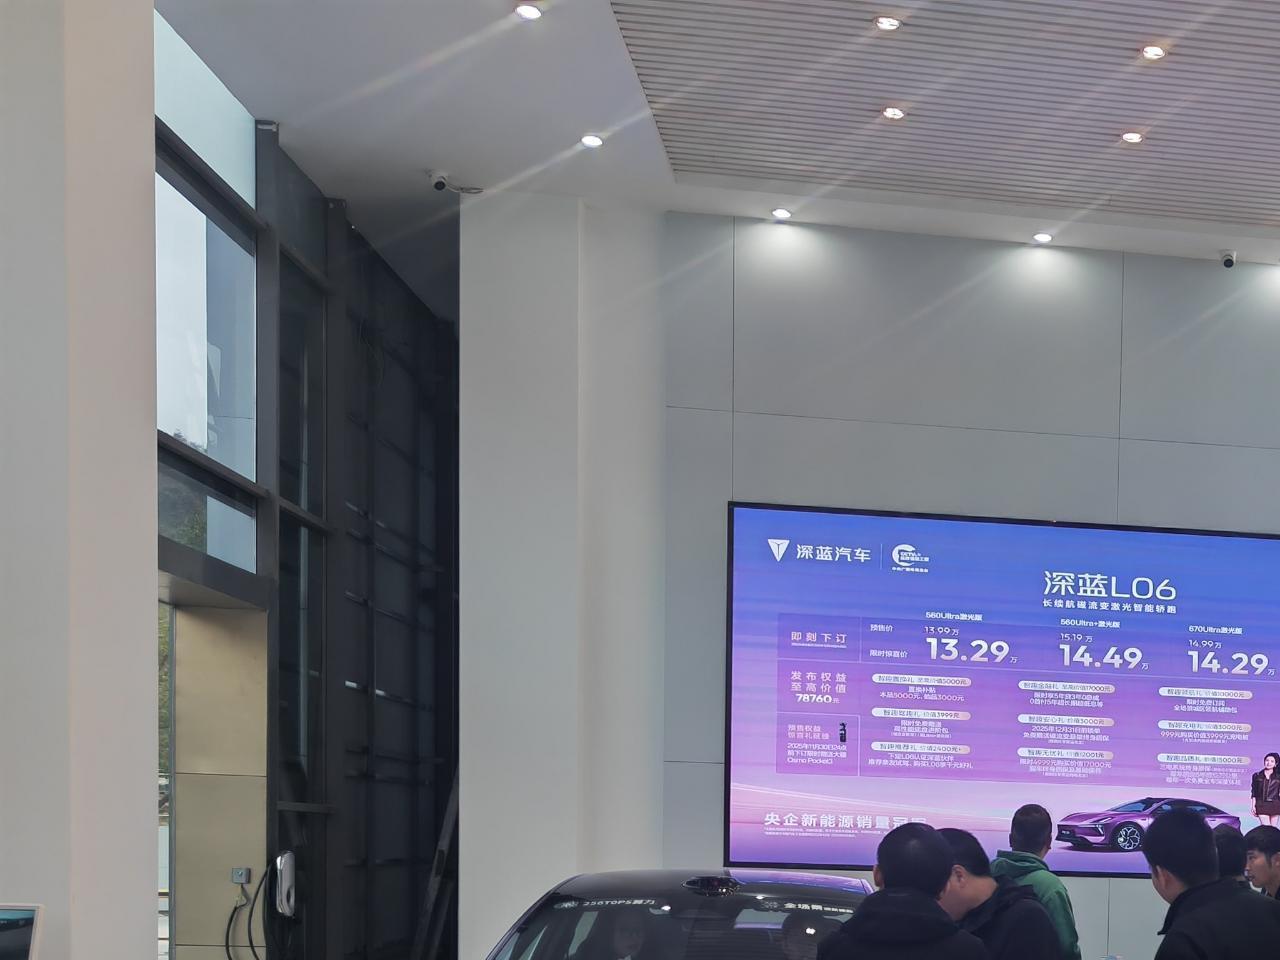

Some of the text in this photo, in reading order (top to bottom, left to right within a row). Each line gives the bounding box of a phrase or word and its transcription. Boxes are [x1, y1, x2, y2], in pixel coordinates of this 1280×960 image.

[796, 544, 871, 563] 深蓝汽车
[1043, 570, 1177, 601] 深蓝L06
[1042, 598, 1177, 614] 长续航磁流变激光智能轿跑
[870, 624, 893, 633] 预售价
[791, 632, 847, 644] 即刻下订
[790, 670, 847, 682] 发布权益
[790, 682, 847, 693] 至高价值
